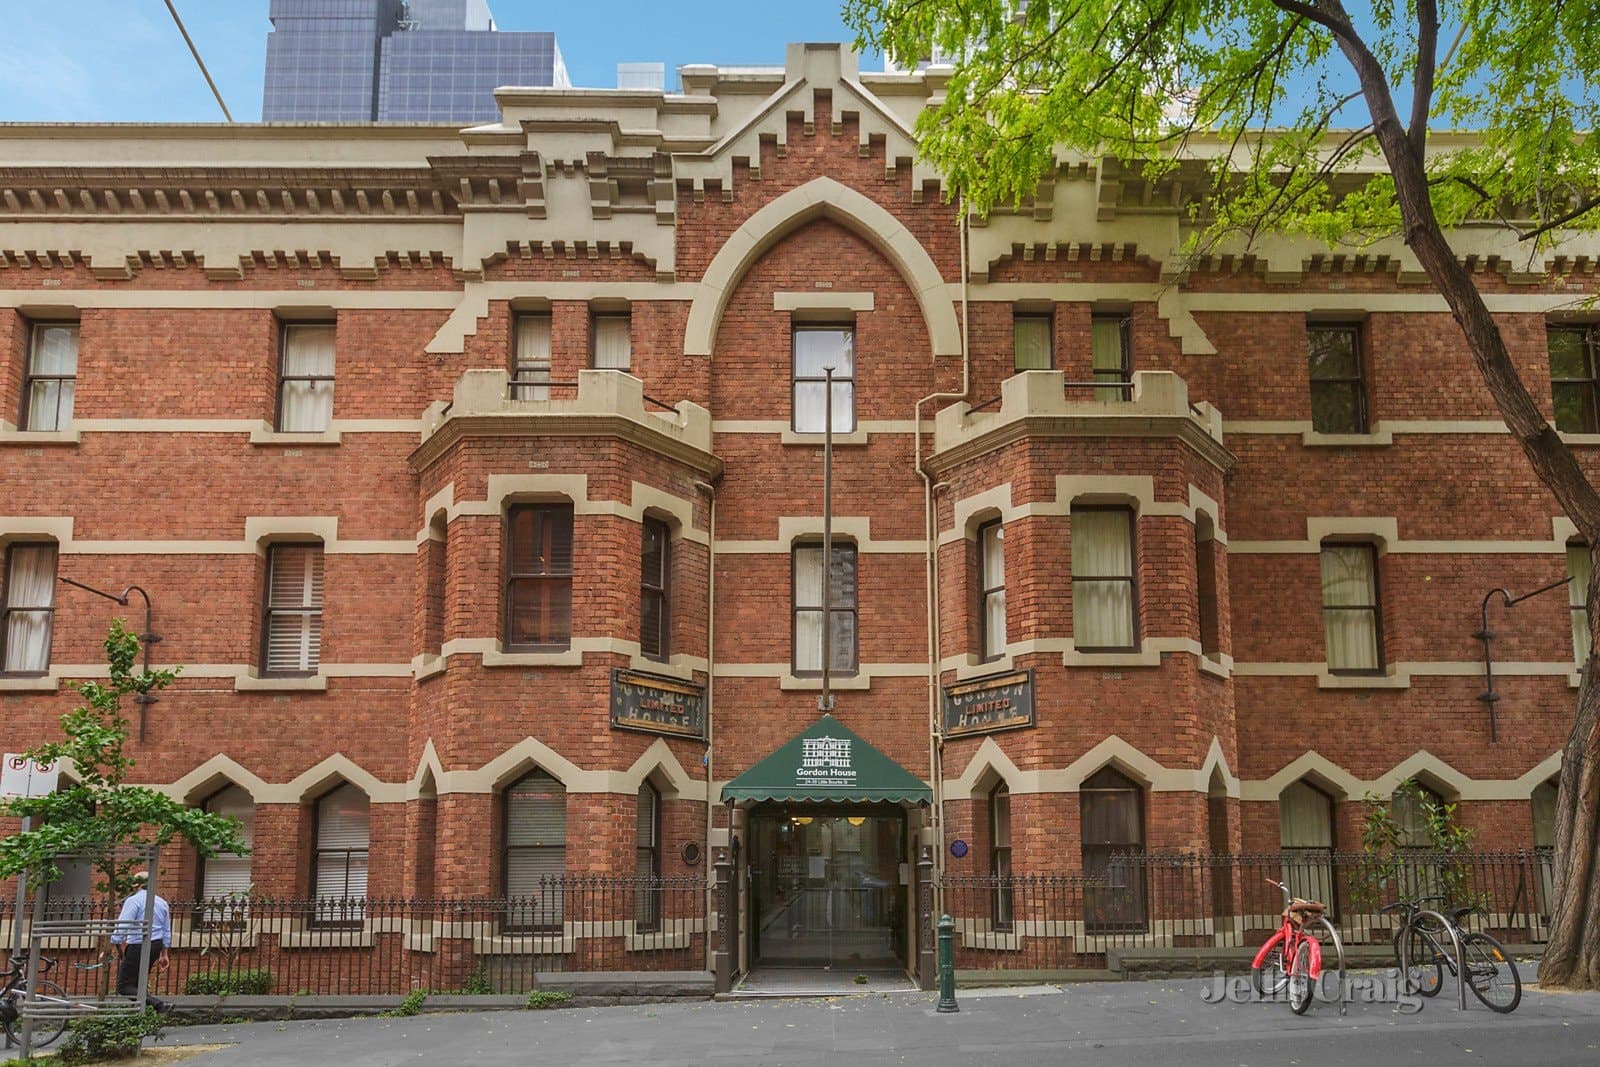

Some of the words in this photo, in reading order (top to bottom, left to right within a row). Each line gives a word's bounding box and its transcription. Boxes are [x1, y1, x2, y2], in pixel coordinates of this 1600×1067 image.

[965, 698, 1010, 715] LIMITED
[796, 768, 828, 776] Gordon
[830, 768, 857, 777] House
